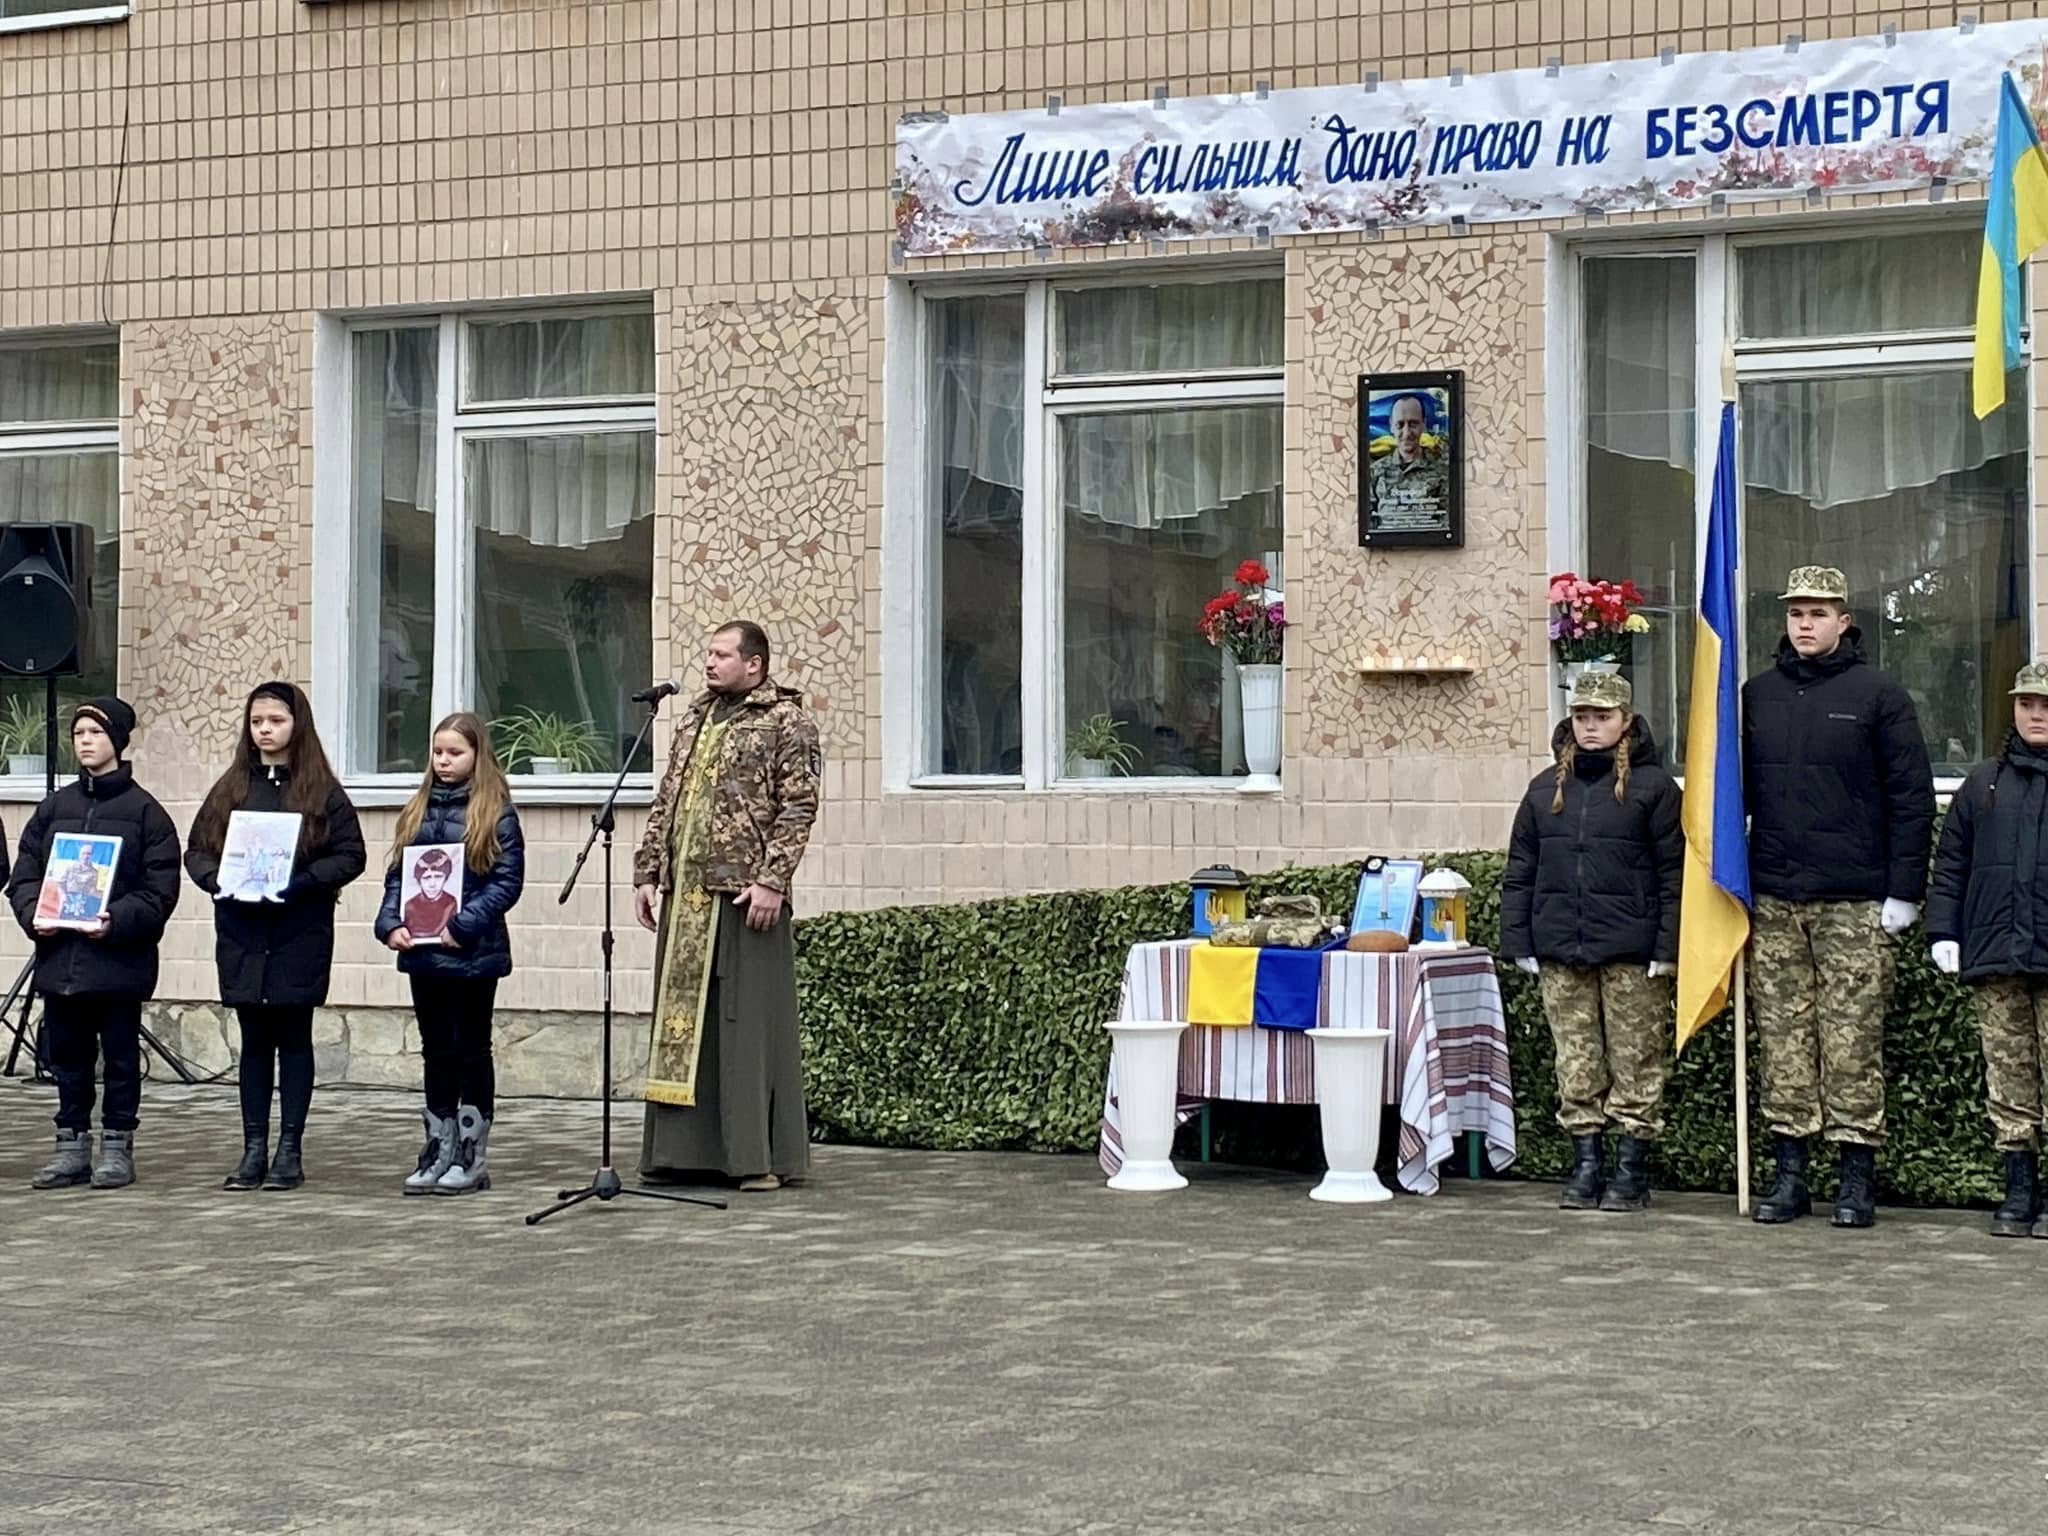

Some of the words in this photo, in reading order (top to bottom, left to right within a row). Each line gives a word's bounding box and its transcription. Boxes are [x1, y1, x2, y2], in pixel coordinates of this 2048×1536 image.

[955, 132, 1109, 206] Лише
[1134, 138, 1301, 195] сильним
[1323, 114, 1416, 184] дано
[1427, 118, 1542, 176] право
[1555, 114, 1611, 167] на
[1645, 79, 1950, 159] БЕЗСМЕРТЯ
